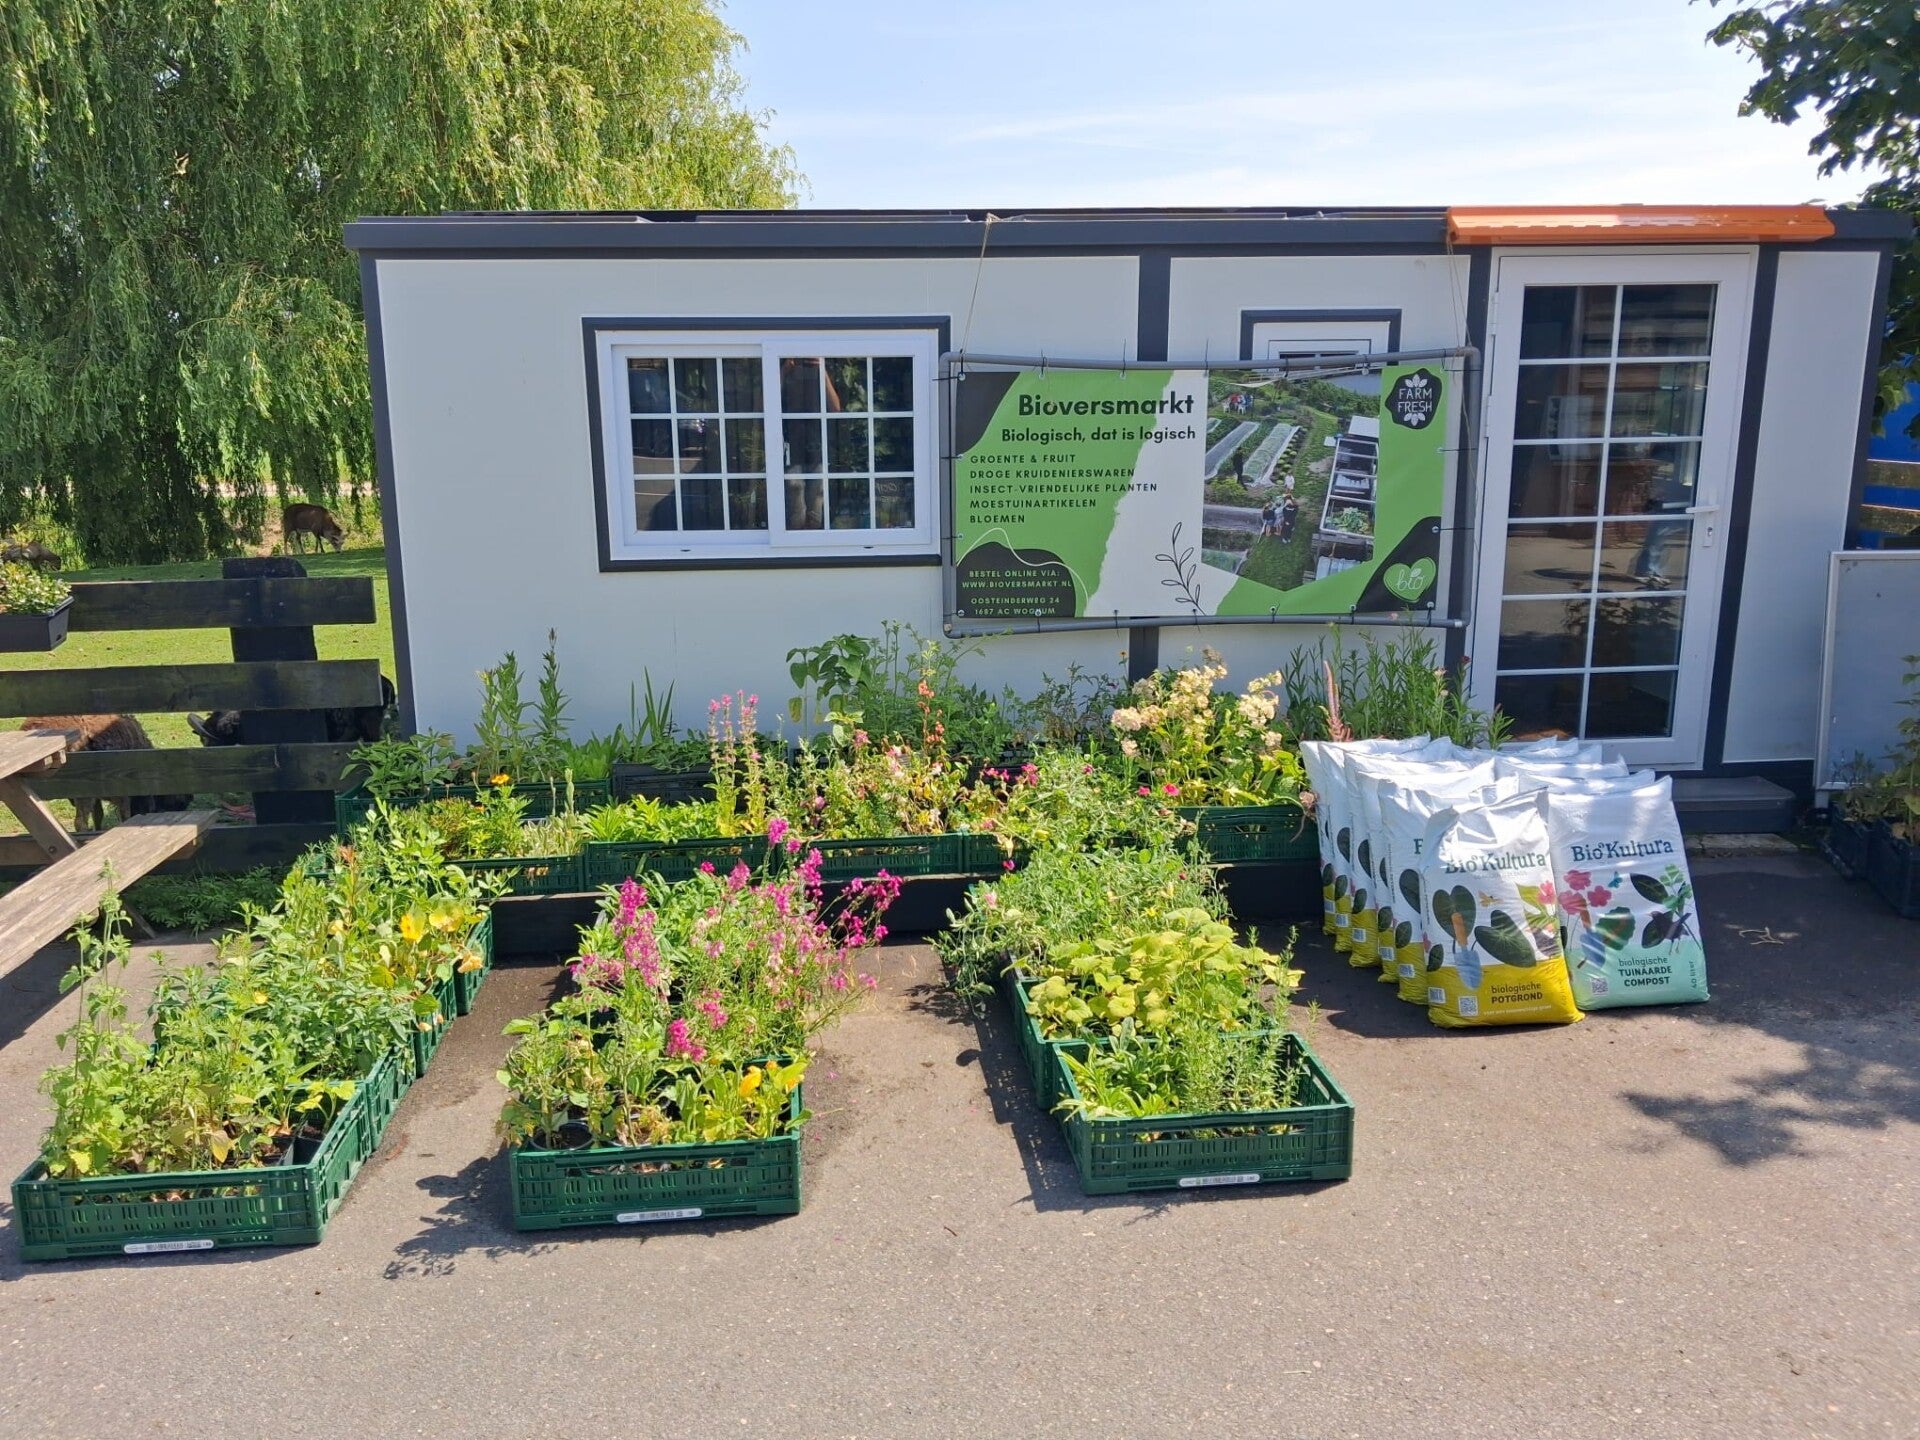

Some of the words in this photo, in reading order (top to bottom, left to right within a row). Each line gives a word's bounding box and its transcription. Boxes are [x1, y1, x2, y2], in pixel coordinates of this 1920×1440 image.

[1399, 388, 1432, 400] FARM
[1019, 391, 1194, 416] Bioversmarkt
[1398, 400, 1432, 412] FRESH
[1002, 427, 1086, 445] Biologisch,
[1091, 427, 1118, 441] dat
[1122, 426, 1135, 440] is
[1140, 425, 1196, 443] logisch
[970, 454, 1025, 464] GROENTE
[1030, 454, 1038, 463] &
[1043, 453, 1076, 463] FRUIT
[970, 469, 1011, 479] DROGE
[1015, 468, 1135, 478] KRUIDENIERSWAREN
[1105, 483, 1158, 493] PLANTEN
[970, 499, 1097, 509] MOESTUINARTIKELEN
[970, 515, 1025, 524] BLOEMEN
[969, 570, 1001, 578] BESTEL
[1004, 569, 1038, 578] ONLINE
[962, 580, 1072, 588] WWW.BIOVERSMARKTNL
[1397, 569, 1425, 590] bio
[971, 597, 1046, 605] OOSTEINDERWEG
[1049, 597, 1061, 605] 24
[997, 608, 1011, 616] AC
[1013, 607, 1056, 616] WOGUM
[1618, 955, 1669, 968] biologische
[1617, 965, 1673, 977] TUINAARDE
[1623, 976, 1671, 987] COMPOST
[1490, 981, 1542, 995] biologische
[1490, 991, 1543, 1005] POTGROND
